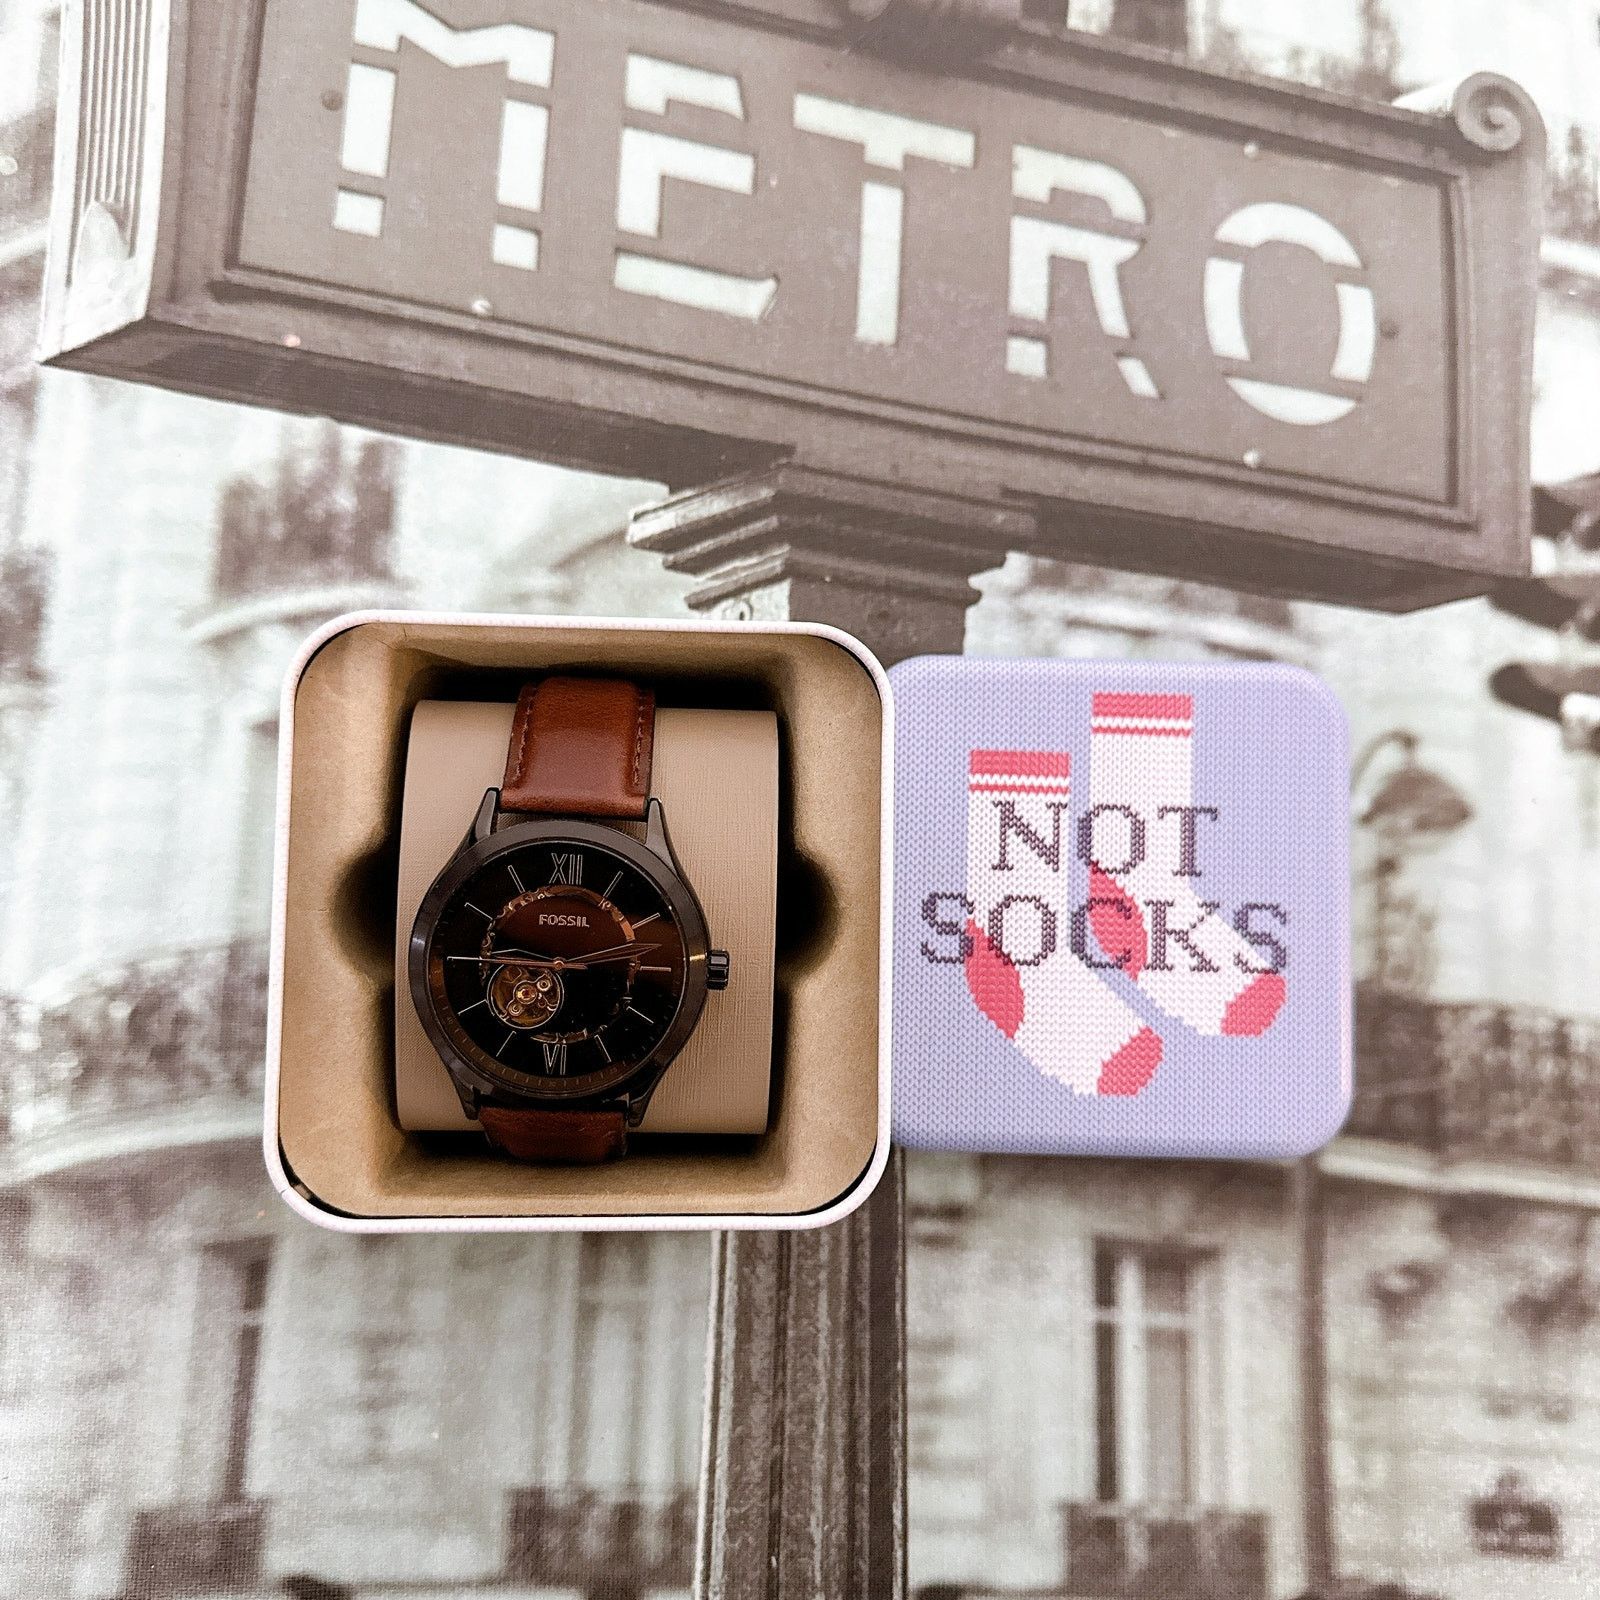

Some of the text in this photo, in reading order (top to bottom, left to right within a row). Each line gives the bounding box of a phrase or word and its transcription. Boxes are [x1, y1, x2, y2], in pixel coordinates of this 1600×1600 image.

[332, 0, 1377, 425] METRO
[991, 800, 1218, 877] NOT
[550, 853, 583, 885] XII
[538, 914, 590, 928] FOSSIL
[920, 892, 1287, 974] SOCKS
[543, 1043, 567, 1076] VI
